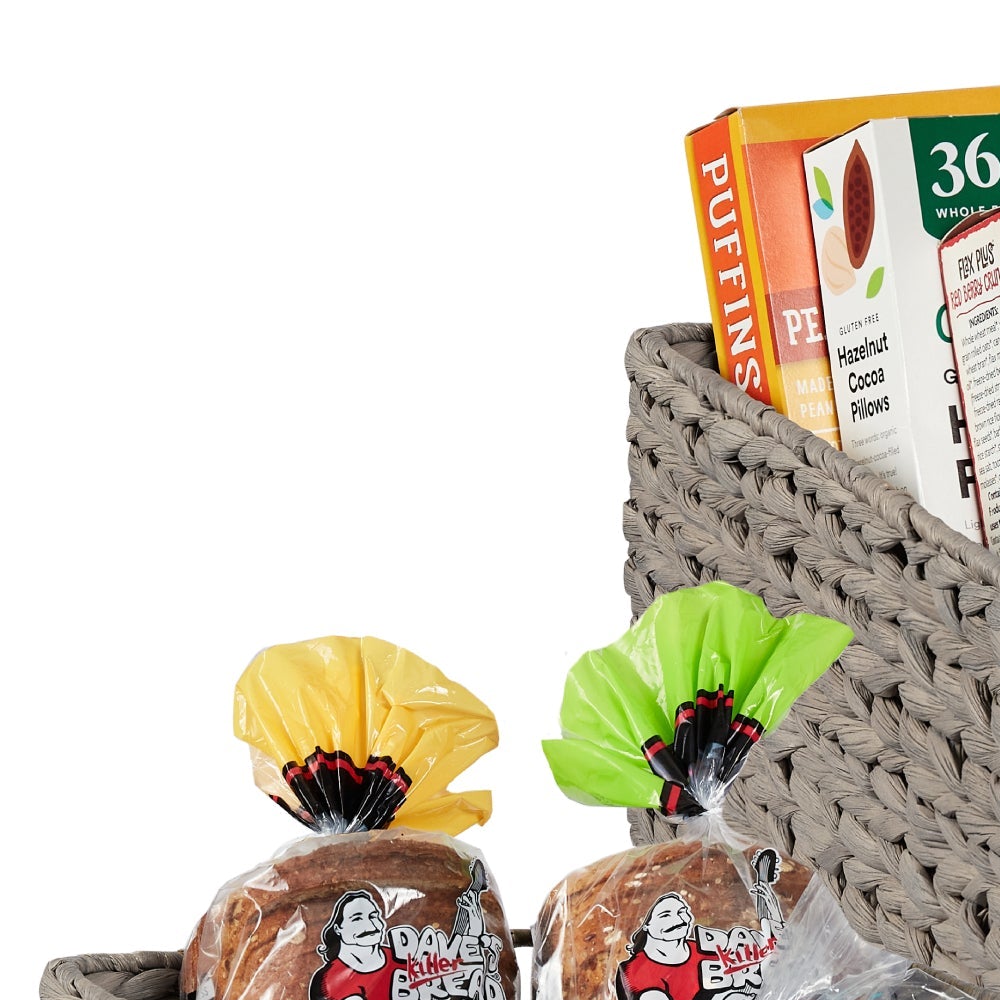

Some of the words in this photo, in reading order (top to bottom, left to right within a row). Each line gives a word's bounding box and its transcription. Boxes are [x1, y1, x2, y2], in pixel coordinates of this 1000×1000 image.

[701, 152, 761, 391] PUFFINS
[976, 242, 995, 271] PLUS
[782, 308, 824, 346] PE
[839, 320, 862, 336] GLUTEN
[864, 313, 880, 325] FREE
[837, 332, 888, 368] Hazelnut
[848, 367, 885, 393] Cocoa
[851, 395, 889, 423] Pillows
[388, 926, 503, 973] DAVE'S
